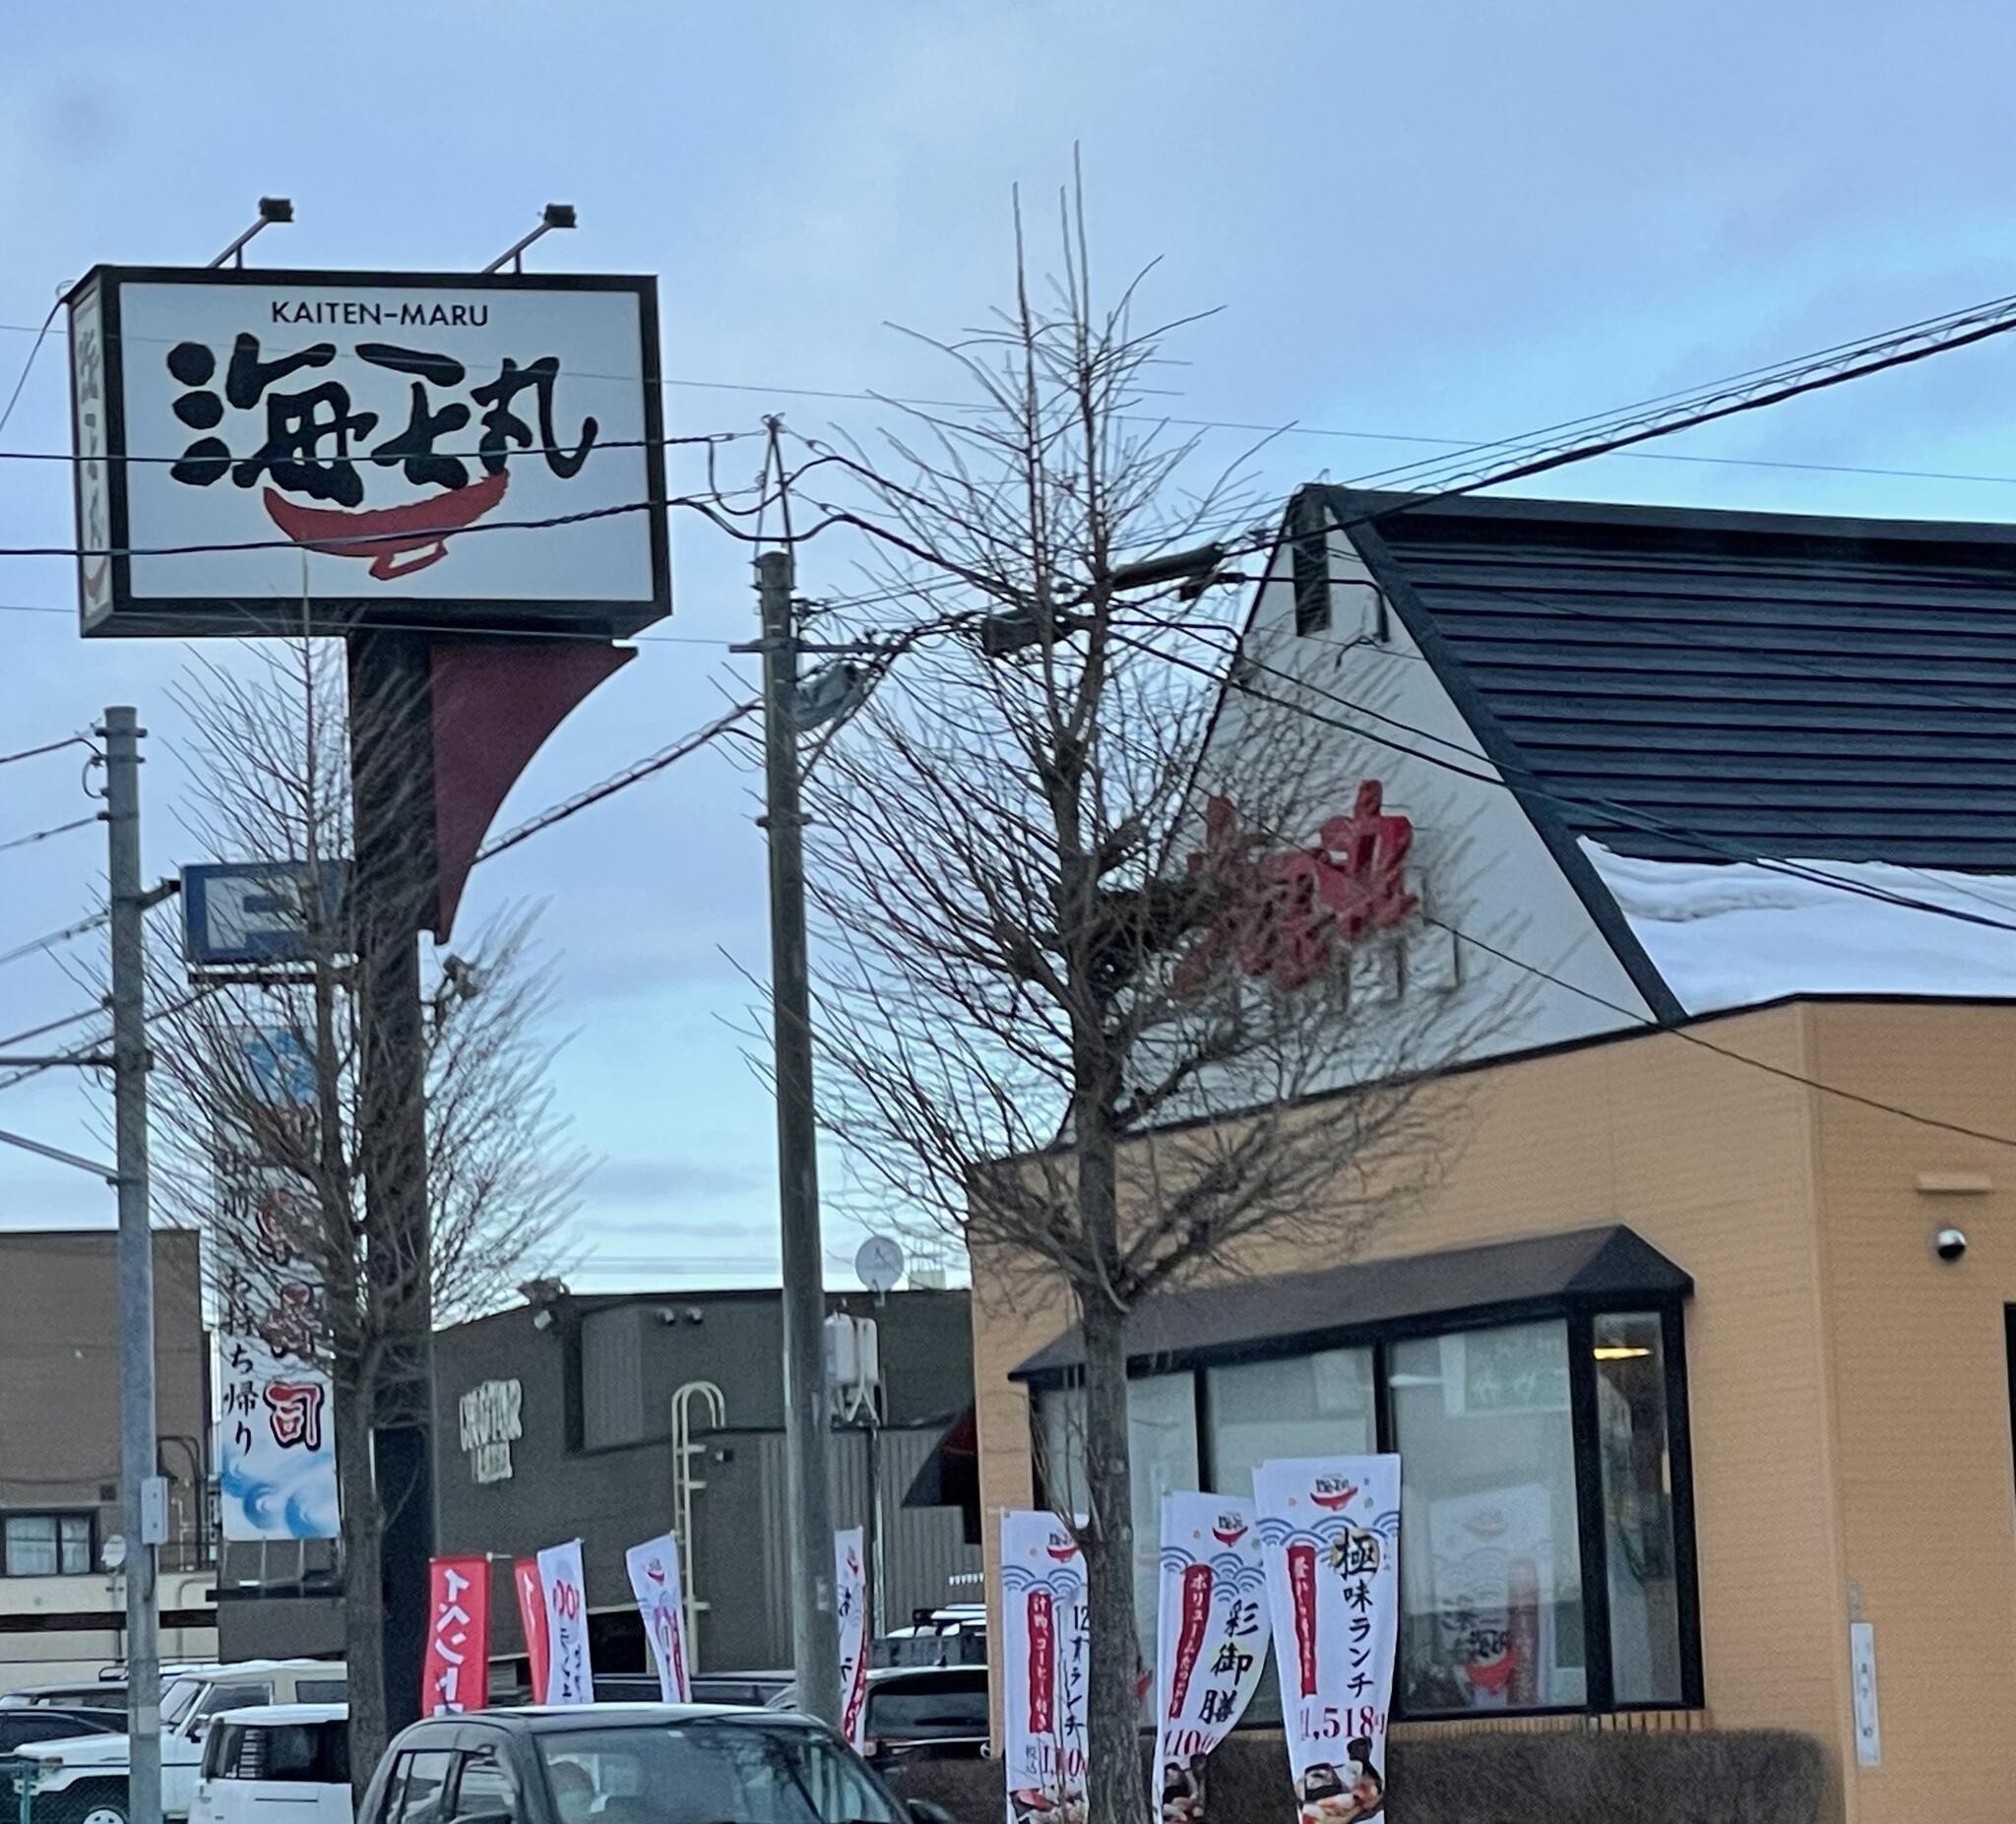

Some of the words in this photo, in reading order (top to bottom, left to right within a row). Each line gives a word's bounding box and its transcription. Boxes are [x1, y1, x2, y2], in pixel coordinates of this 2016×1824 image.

[271, 300, 490, 329] KAITEN-MARU
[1198, 1599, 1260, 1726] 彩御膳
[1335, 1526, 1380, 1700] 極味ランチ
